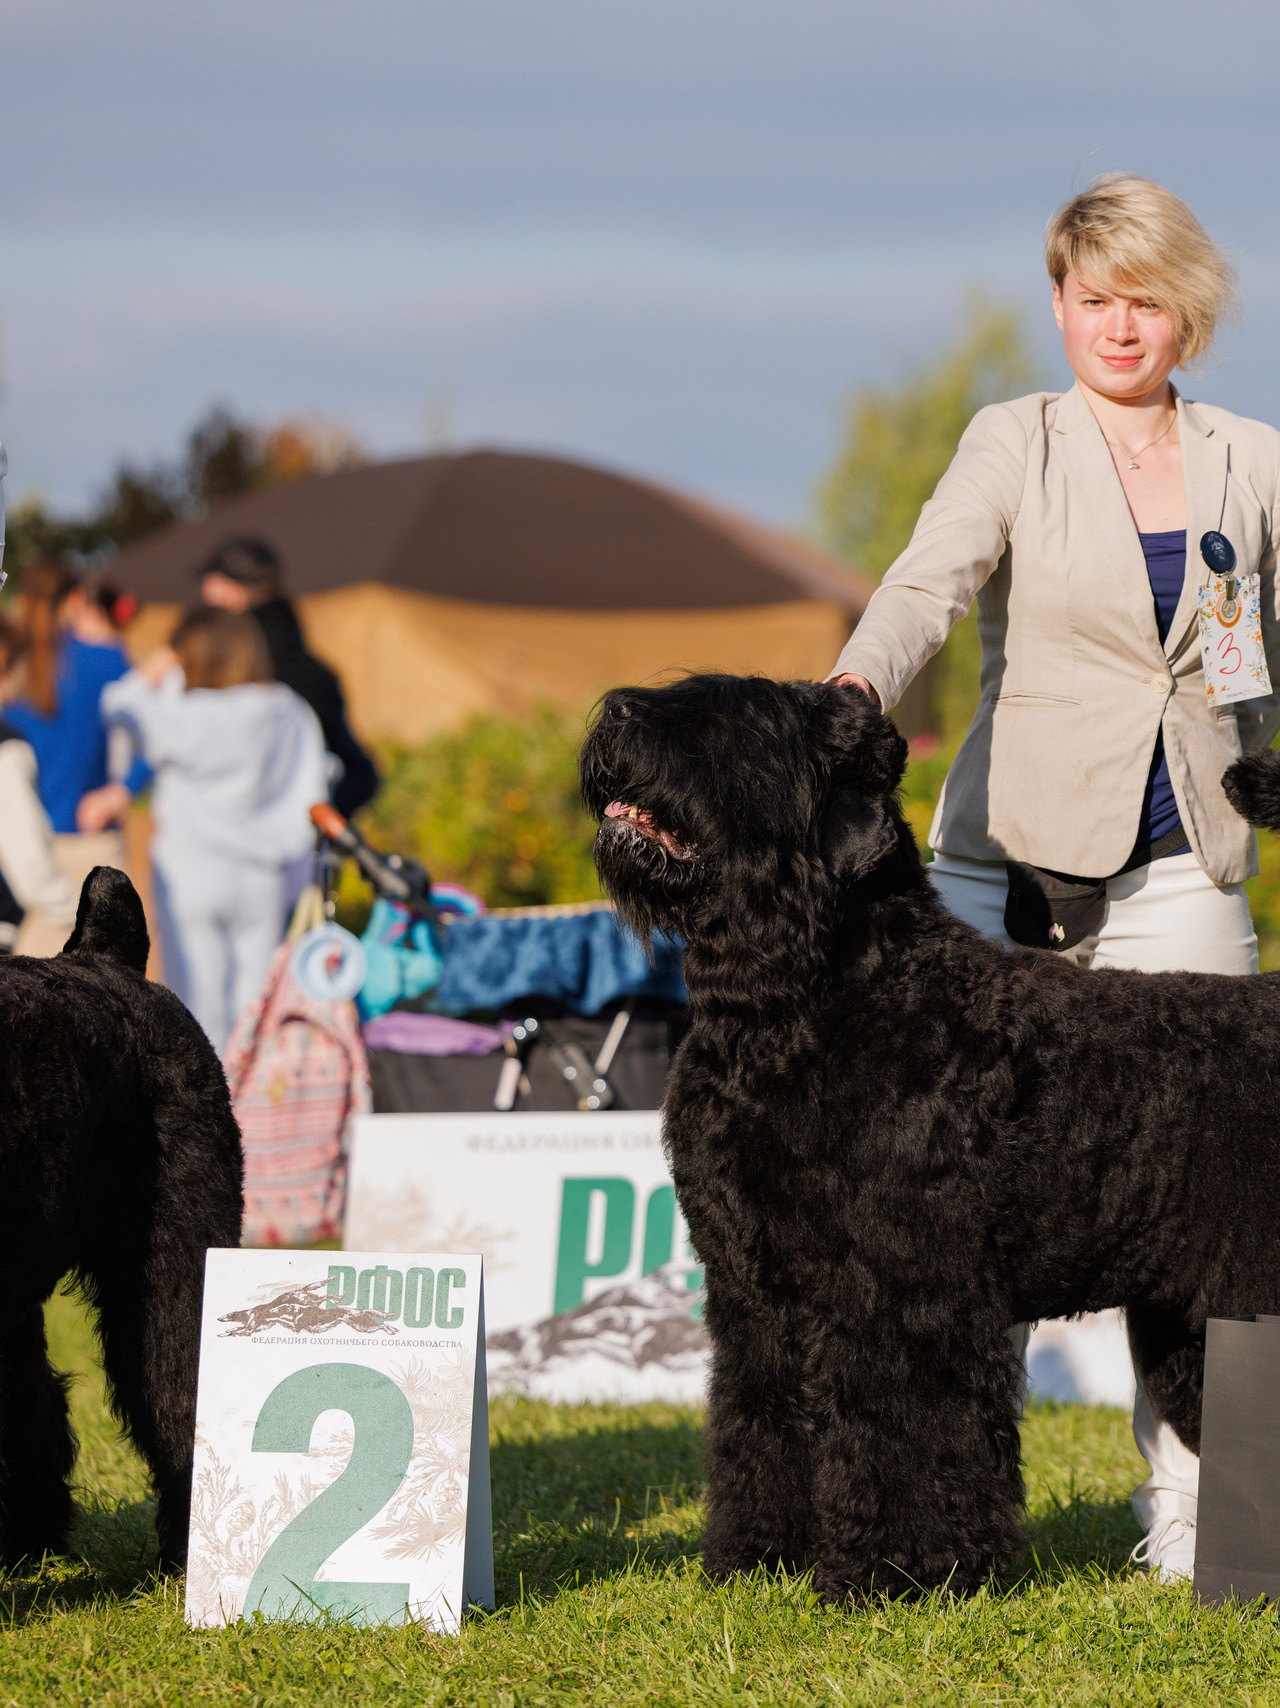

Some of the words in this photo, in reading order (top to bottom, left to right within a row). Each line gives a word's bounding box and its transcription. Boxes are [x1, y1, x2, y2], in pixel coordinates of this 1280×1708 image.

[1217, 632, 1242, 674] 3
[325, 1265, 467, 1329] РФОС
[251, 1337, 307, 1345] ФЕДЕРАЦИЯ
[310, 1338, 379, 1346] ОХОТНИЧЬЕГО
[381, 1339, 463, 1348] СОБАКОВОДСТВА
[242, 1362, 414, 1627] 2
